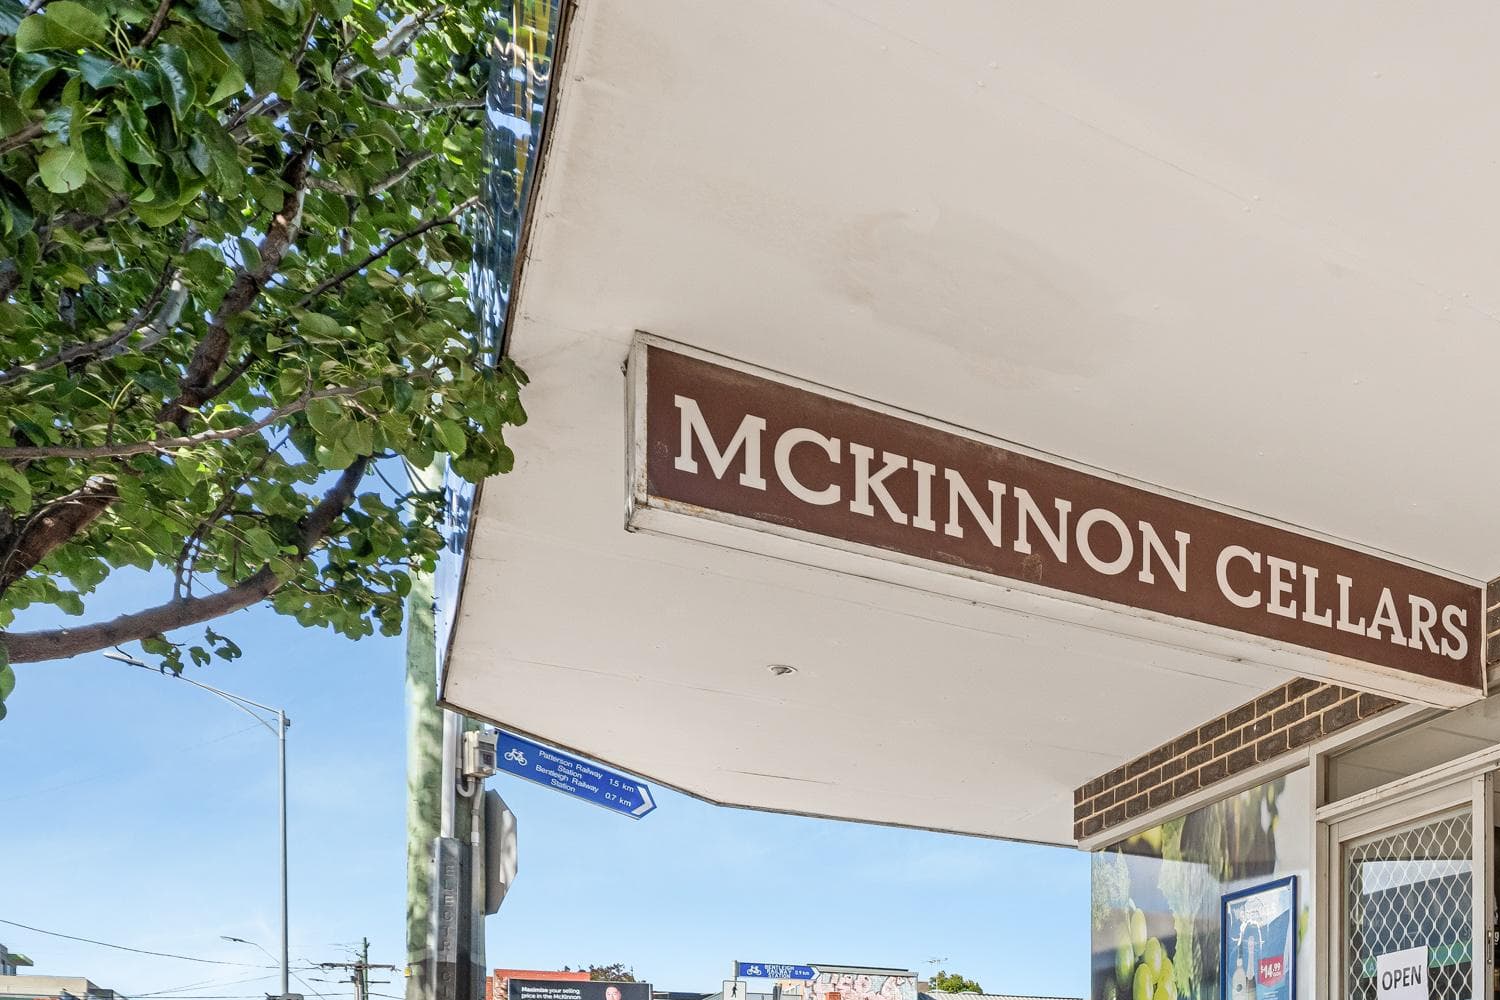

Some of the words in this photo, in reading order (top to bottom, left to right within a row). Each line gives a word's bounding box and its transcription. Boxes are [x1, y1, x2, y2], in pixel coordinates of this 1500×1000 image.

[674, 395, 1190, 592] MCKINNON
[1215, 544, 1470, 660] CELLARS
[535, 765, 569, 782] Bentleigh
[571, 777, 599, 793] Railway
[605, 792, 615, 801] 0.7
[619, 797, 631, 807] km
[539, 750, 573, 768] Patterson
[576, 763, 603, 779] Railway
[609, 778, 620, 787] 1.5
[622, 783, 635, 793] km
[550, 779, 576, 792] Station
[557, 765, 582, 780] Station
[1382, 965, 1422, 991] OPEN
